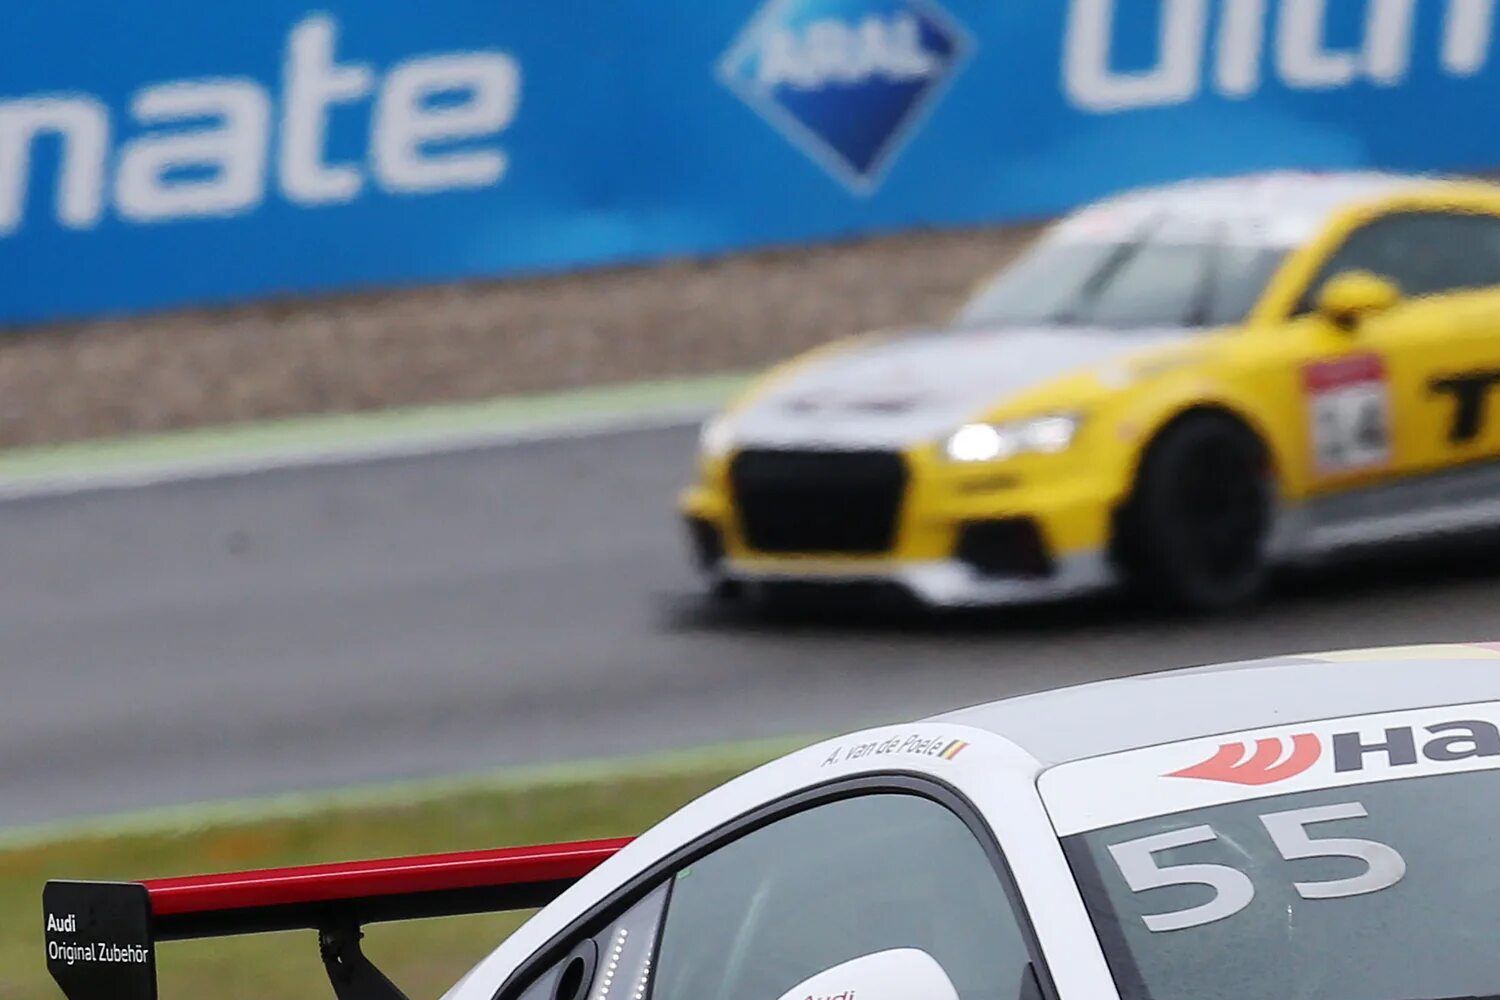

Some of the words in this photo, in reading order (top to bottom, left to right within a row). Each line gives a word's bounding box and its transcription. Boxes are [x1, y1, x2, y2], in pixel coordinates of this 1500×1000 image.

[877, 734, 900, 755] de
[1106, 801, 1406, 932] 55
[47, 913, 76, 932] Audi
[49, 941, 97, 965] Original
[98, 943, 149, 963] Zubehör
